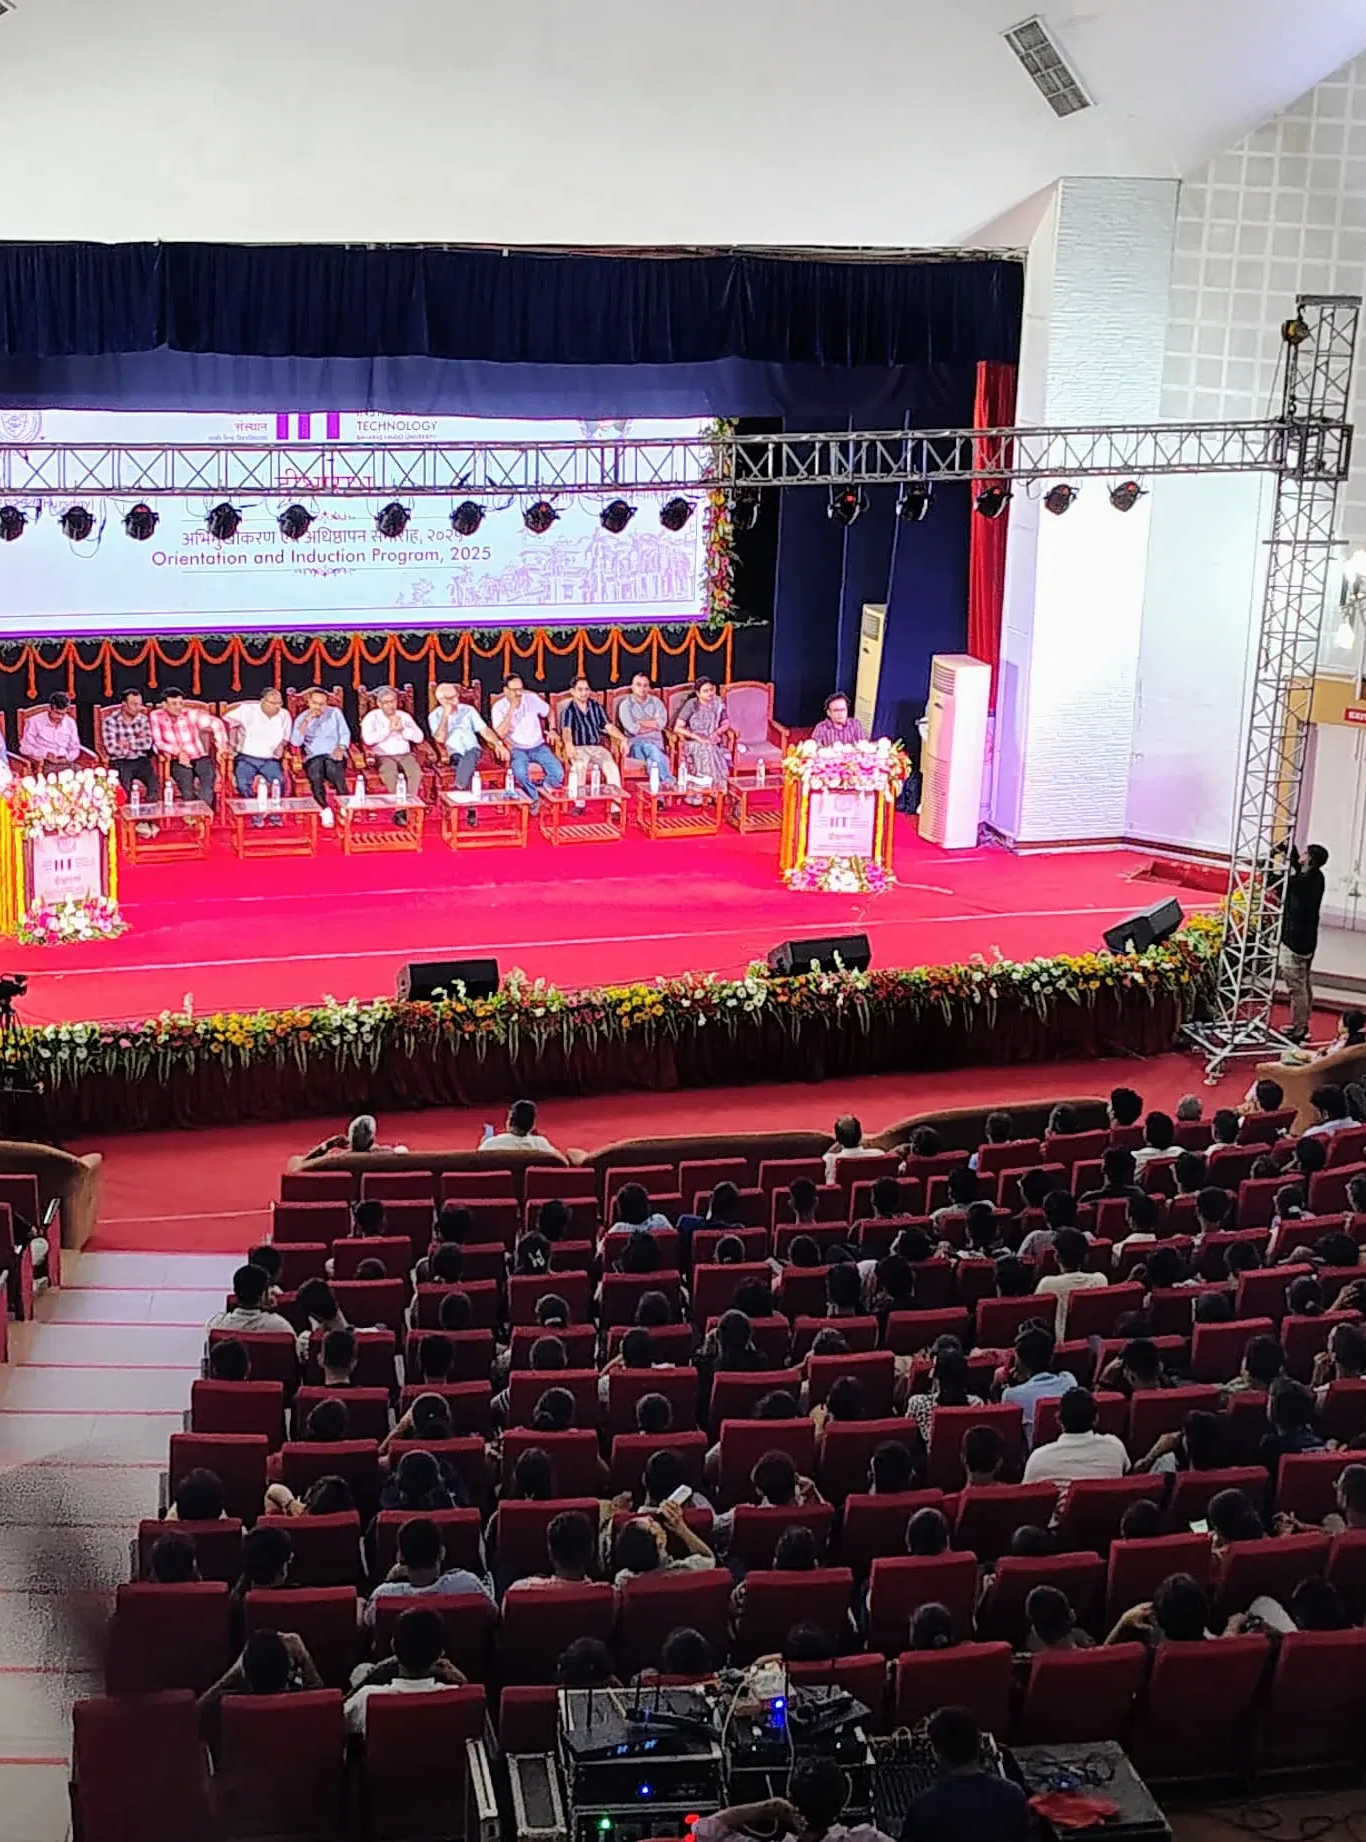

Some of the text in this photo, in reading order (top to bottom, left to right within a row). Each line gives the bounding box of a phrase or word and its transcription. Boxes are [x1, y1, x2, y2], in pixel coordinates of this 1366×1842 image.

[356, 420, 437, 431] TECHNOLOGY
[152, 547, 491, 566] Orientation and Induction Program, 2025
